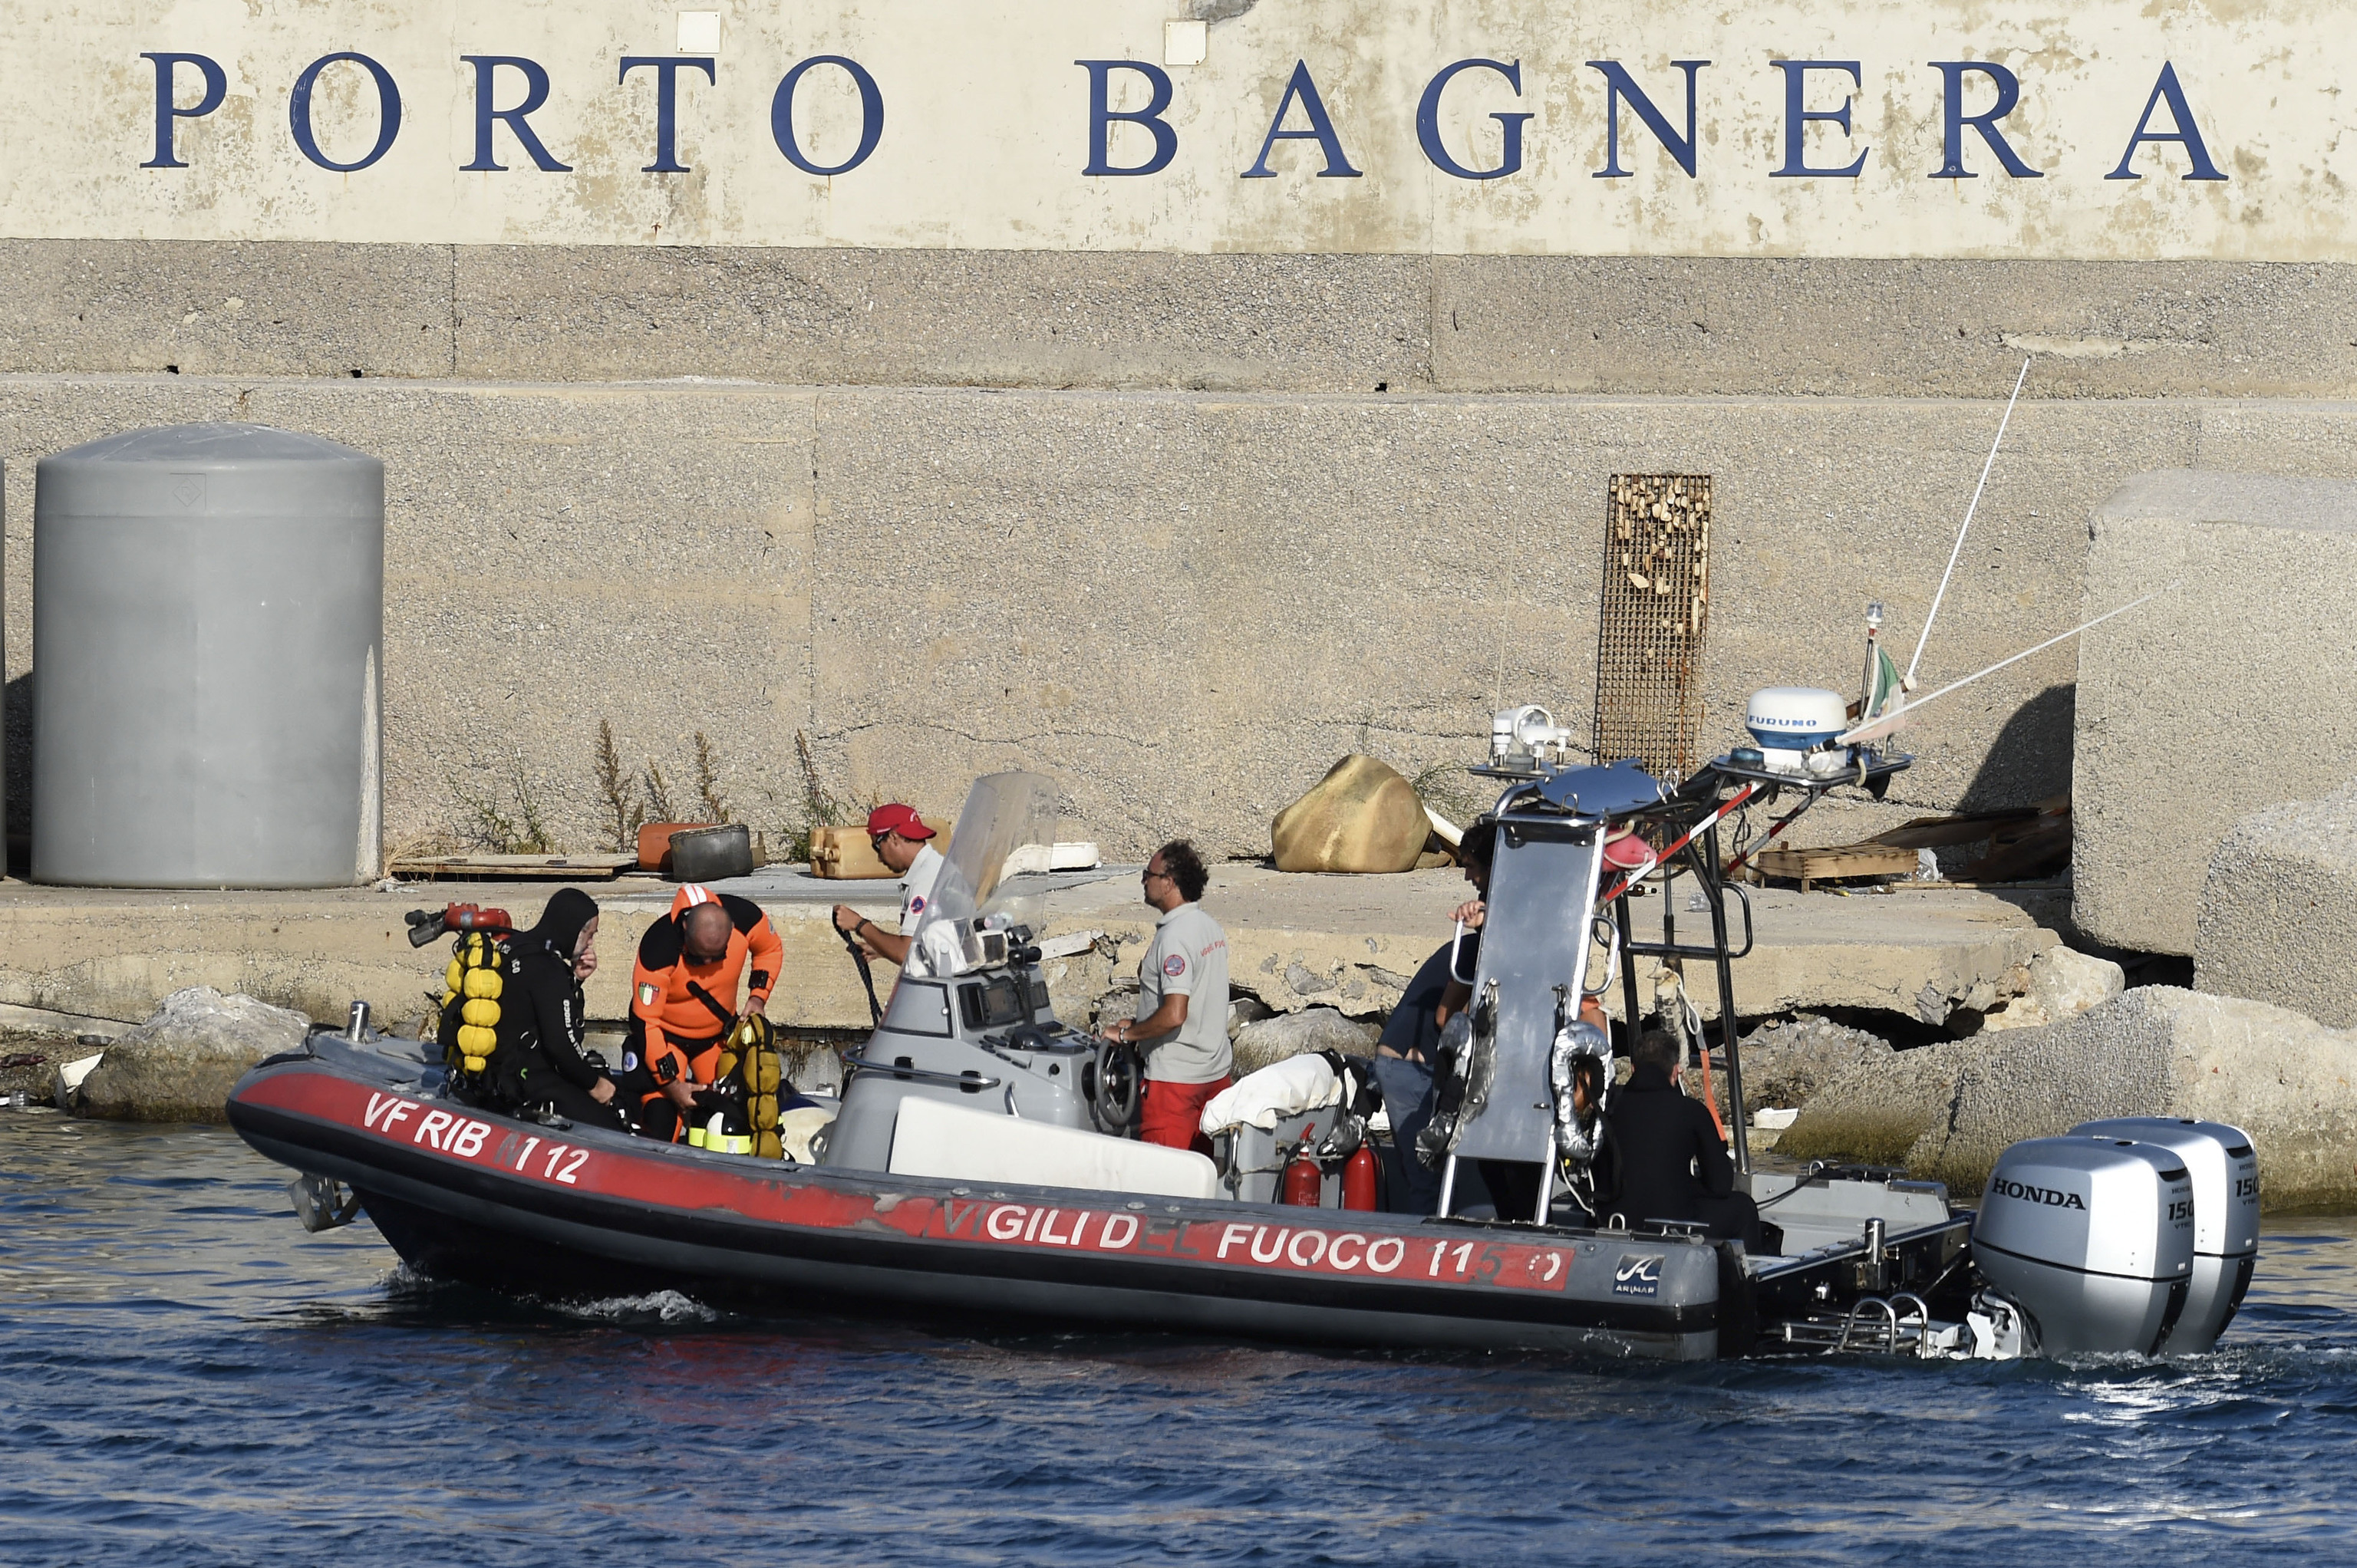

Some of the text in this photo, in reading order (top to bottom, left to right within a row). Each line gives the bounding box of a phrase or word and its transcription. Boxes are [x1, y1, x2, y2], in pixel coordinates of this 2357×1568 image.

[140, 51, 2229, 180] PORTO BAGNERA
[1749, 715, 1818, 727] FURUNO
[364, 1092, 420, 1133] VF
[414, 1109, 492, 1158] RIB
[1992, 1178, 2087, 1211] HONDA
[2235, 1175, 2260, 1197] 150
[1216, 1224, 1406, 1273] FUOCO
[1616, 1284, 1655, 1295] ARIMAR
